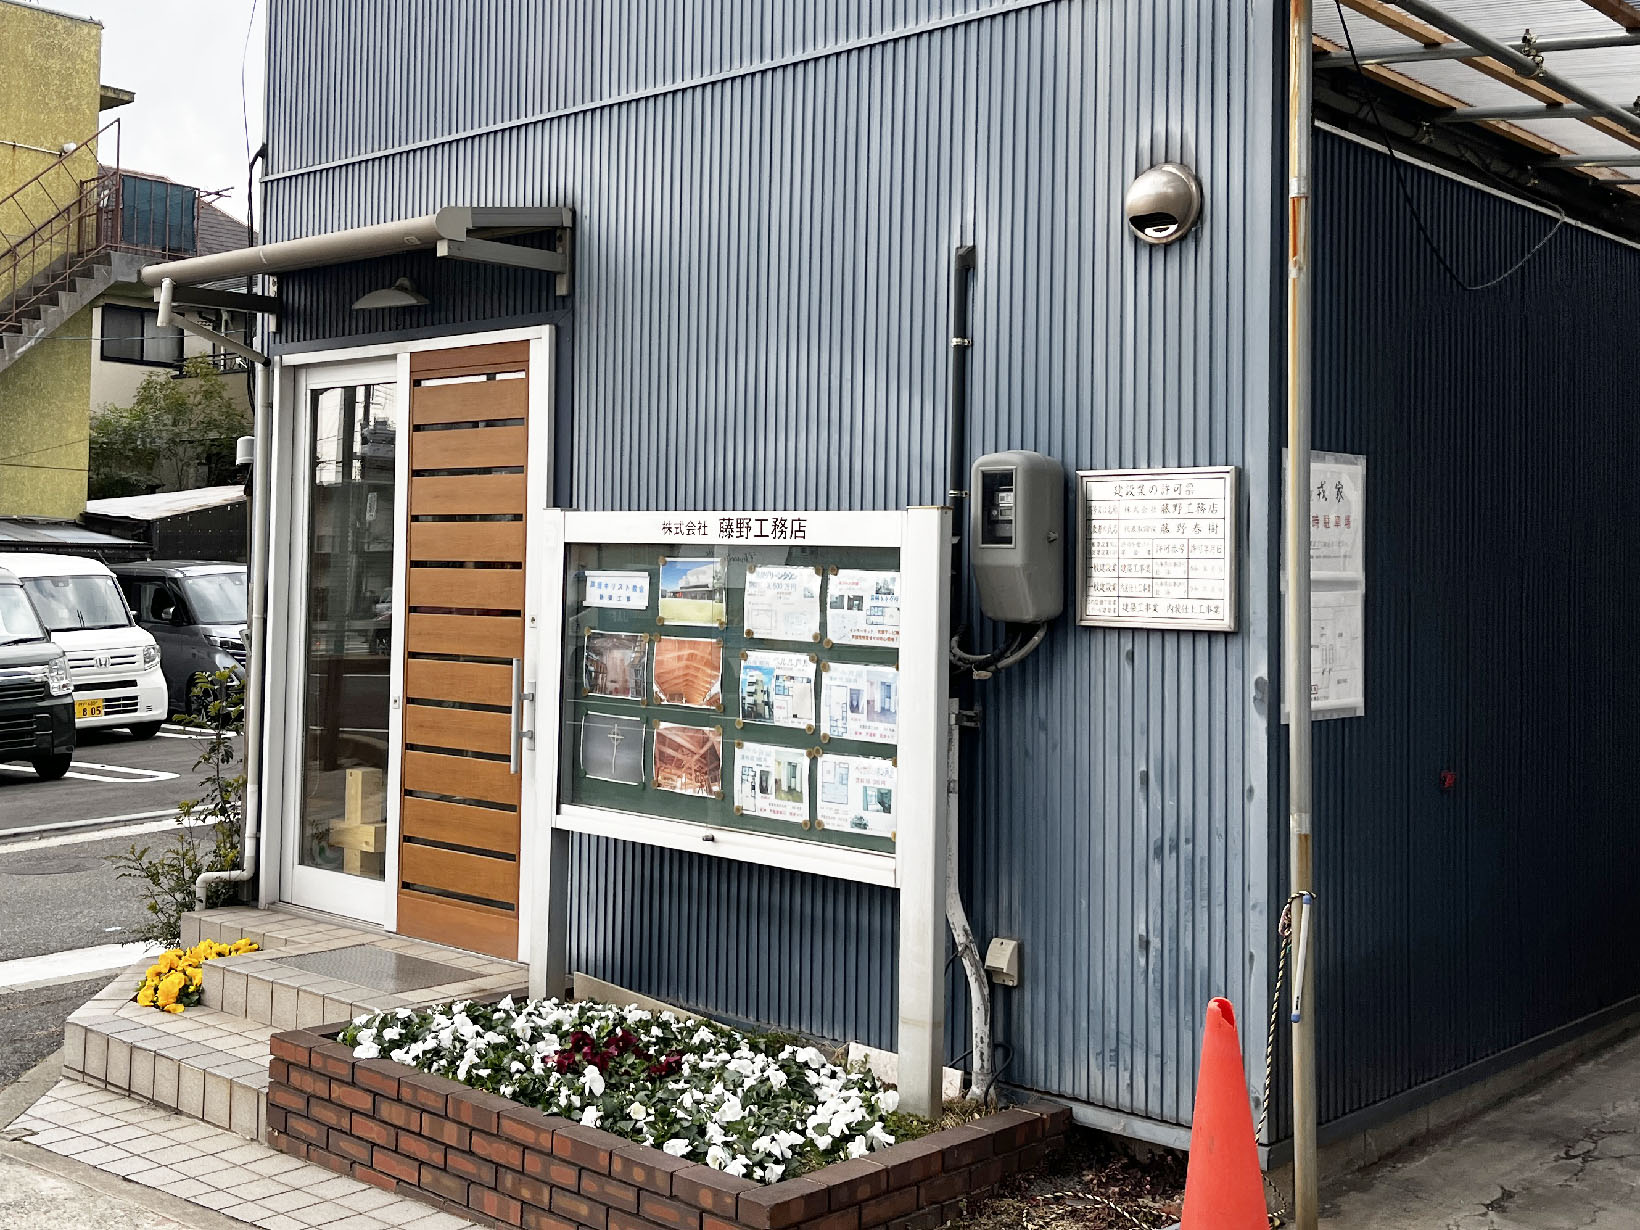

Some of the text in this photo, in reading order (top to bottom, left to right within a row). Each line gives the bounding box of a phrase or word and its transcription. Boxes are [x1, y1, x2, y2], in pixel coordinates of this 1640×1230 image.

[1114, 482, 1195, 498] 建設業の許可票
[1161, 502, 1219, 515] 藤野工務店
[661, 517, 808, 540] 株式会社 藤野工務店
[1122, 602, 1159, 613] 建築工事業
